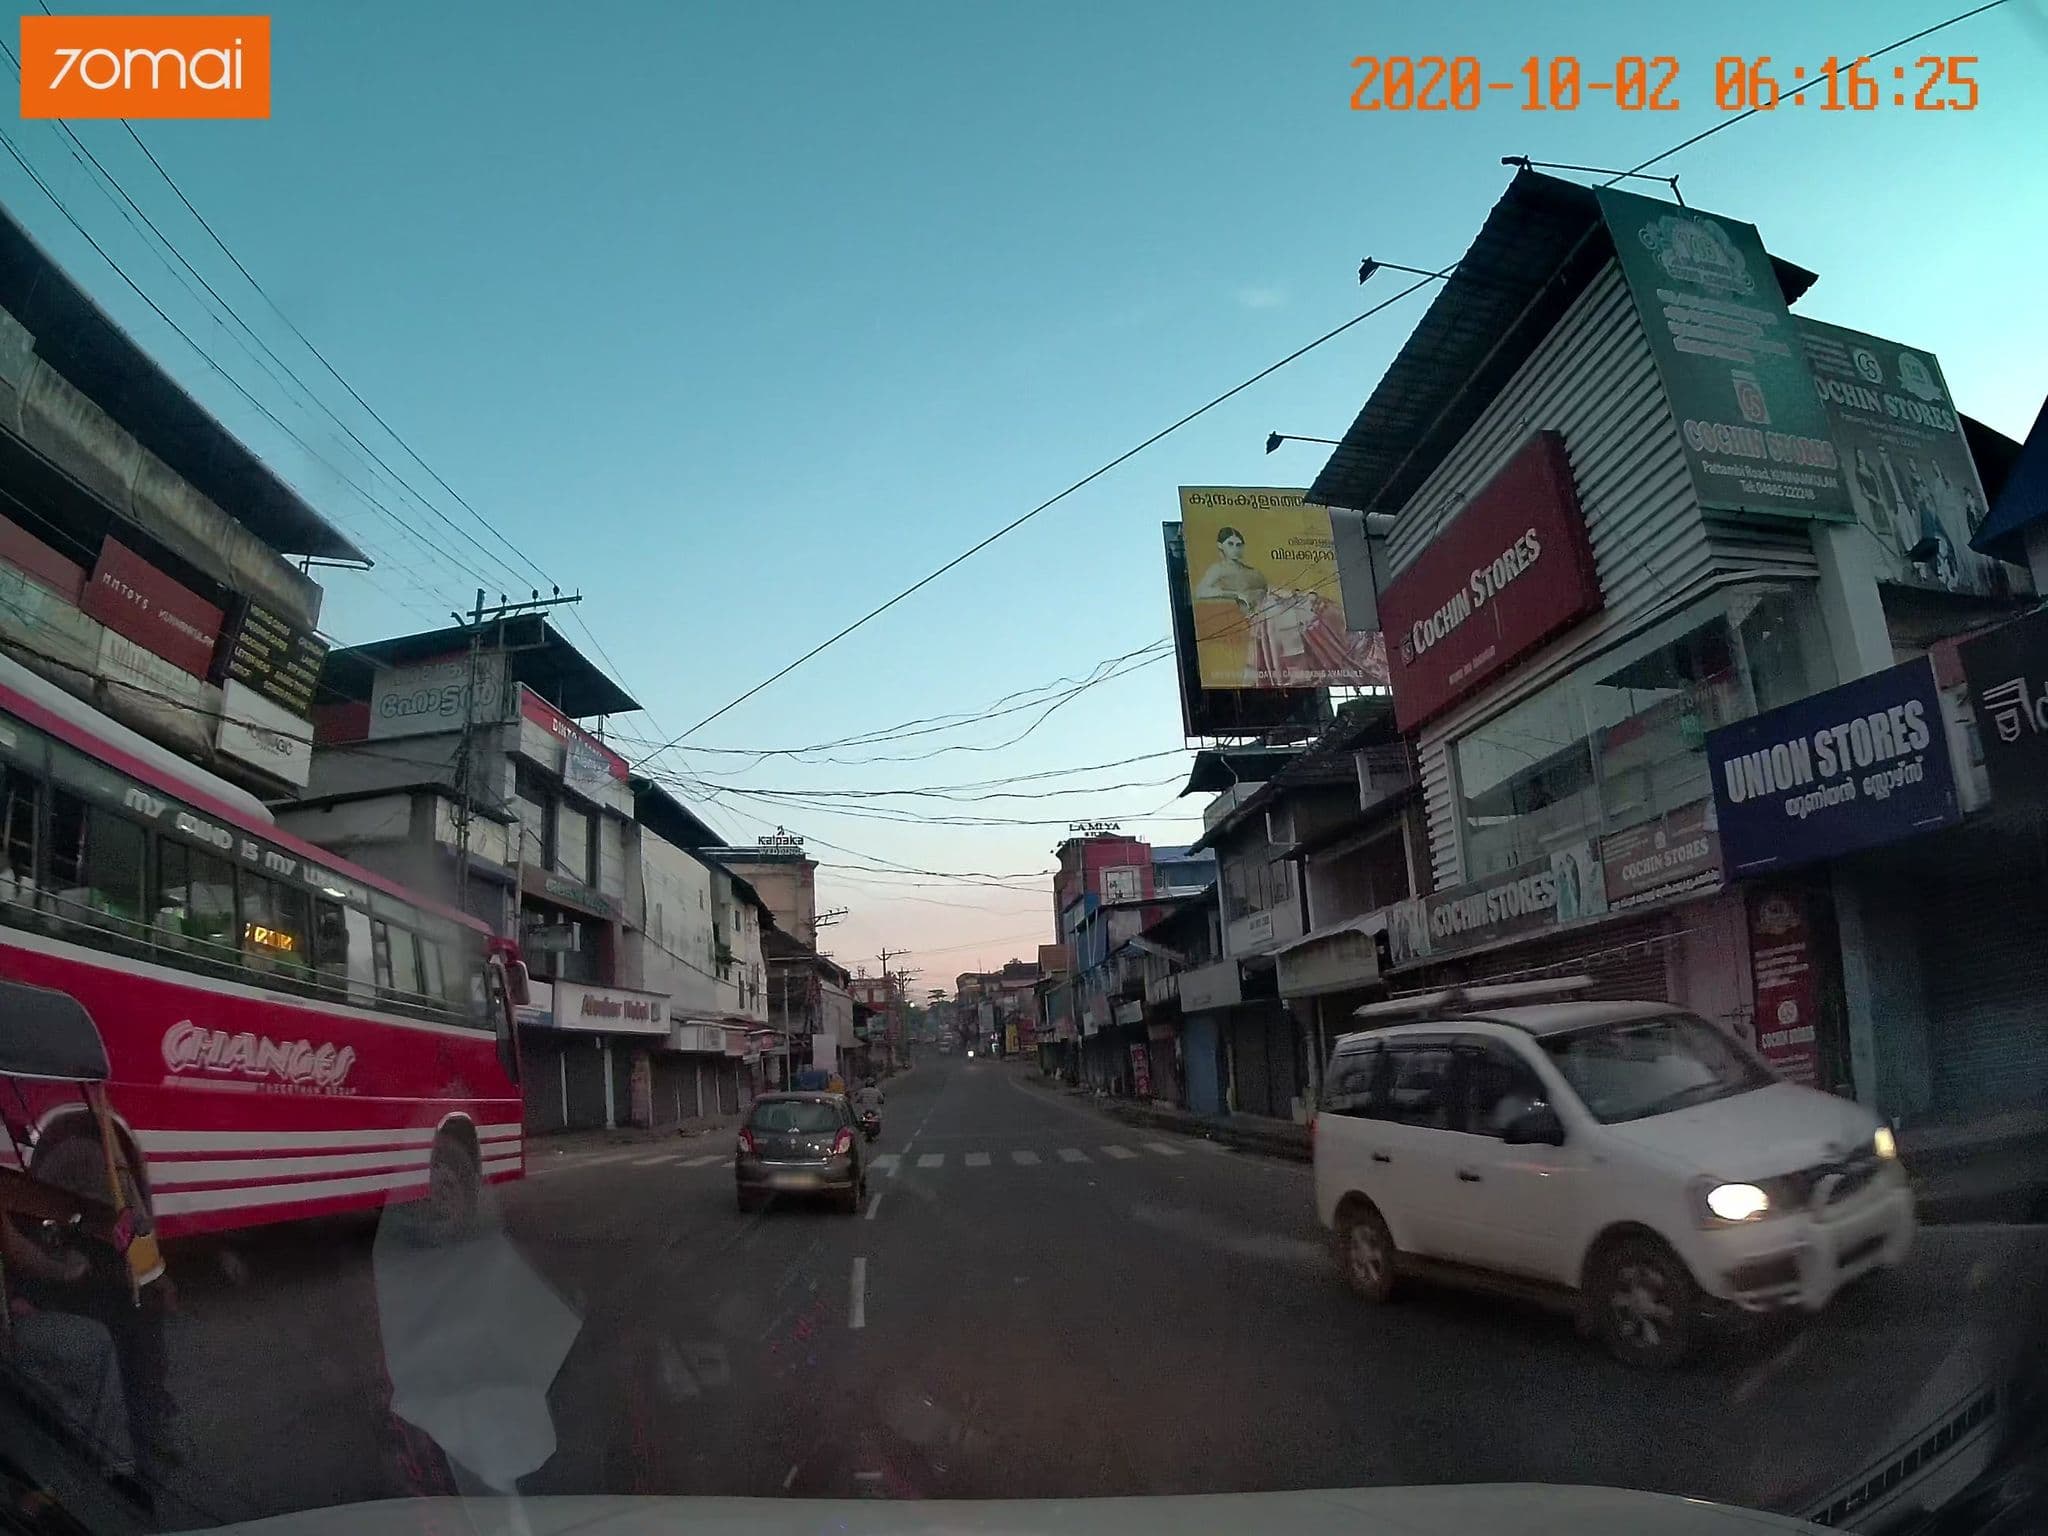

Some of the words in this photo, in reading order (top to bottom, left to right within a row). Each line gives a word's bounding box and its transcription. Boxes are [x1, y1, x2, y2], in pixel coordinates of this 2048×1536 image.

[1884, 394, 1955, 432] STORES
[1683, 419, 1767, 458] COCHIN
[1412, 587, 1472, 654] COCHIN
[1470, 528, 1541, 607] STORES
[1724, 737, 1814, 804] UNION
[1814, 700, 1931, 778] STORES
[1622, 854, 1663, 881] COCHIN
[1663, 838, 1709, 867] STORES
[1486, 872, 1557, 923] STORES
